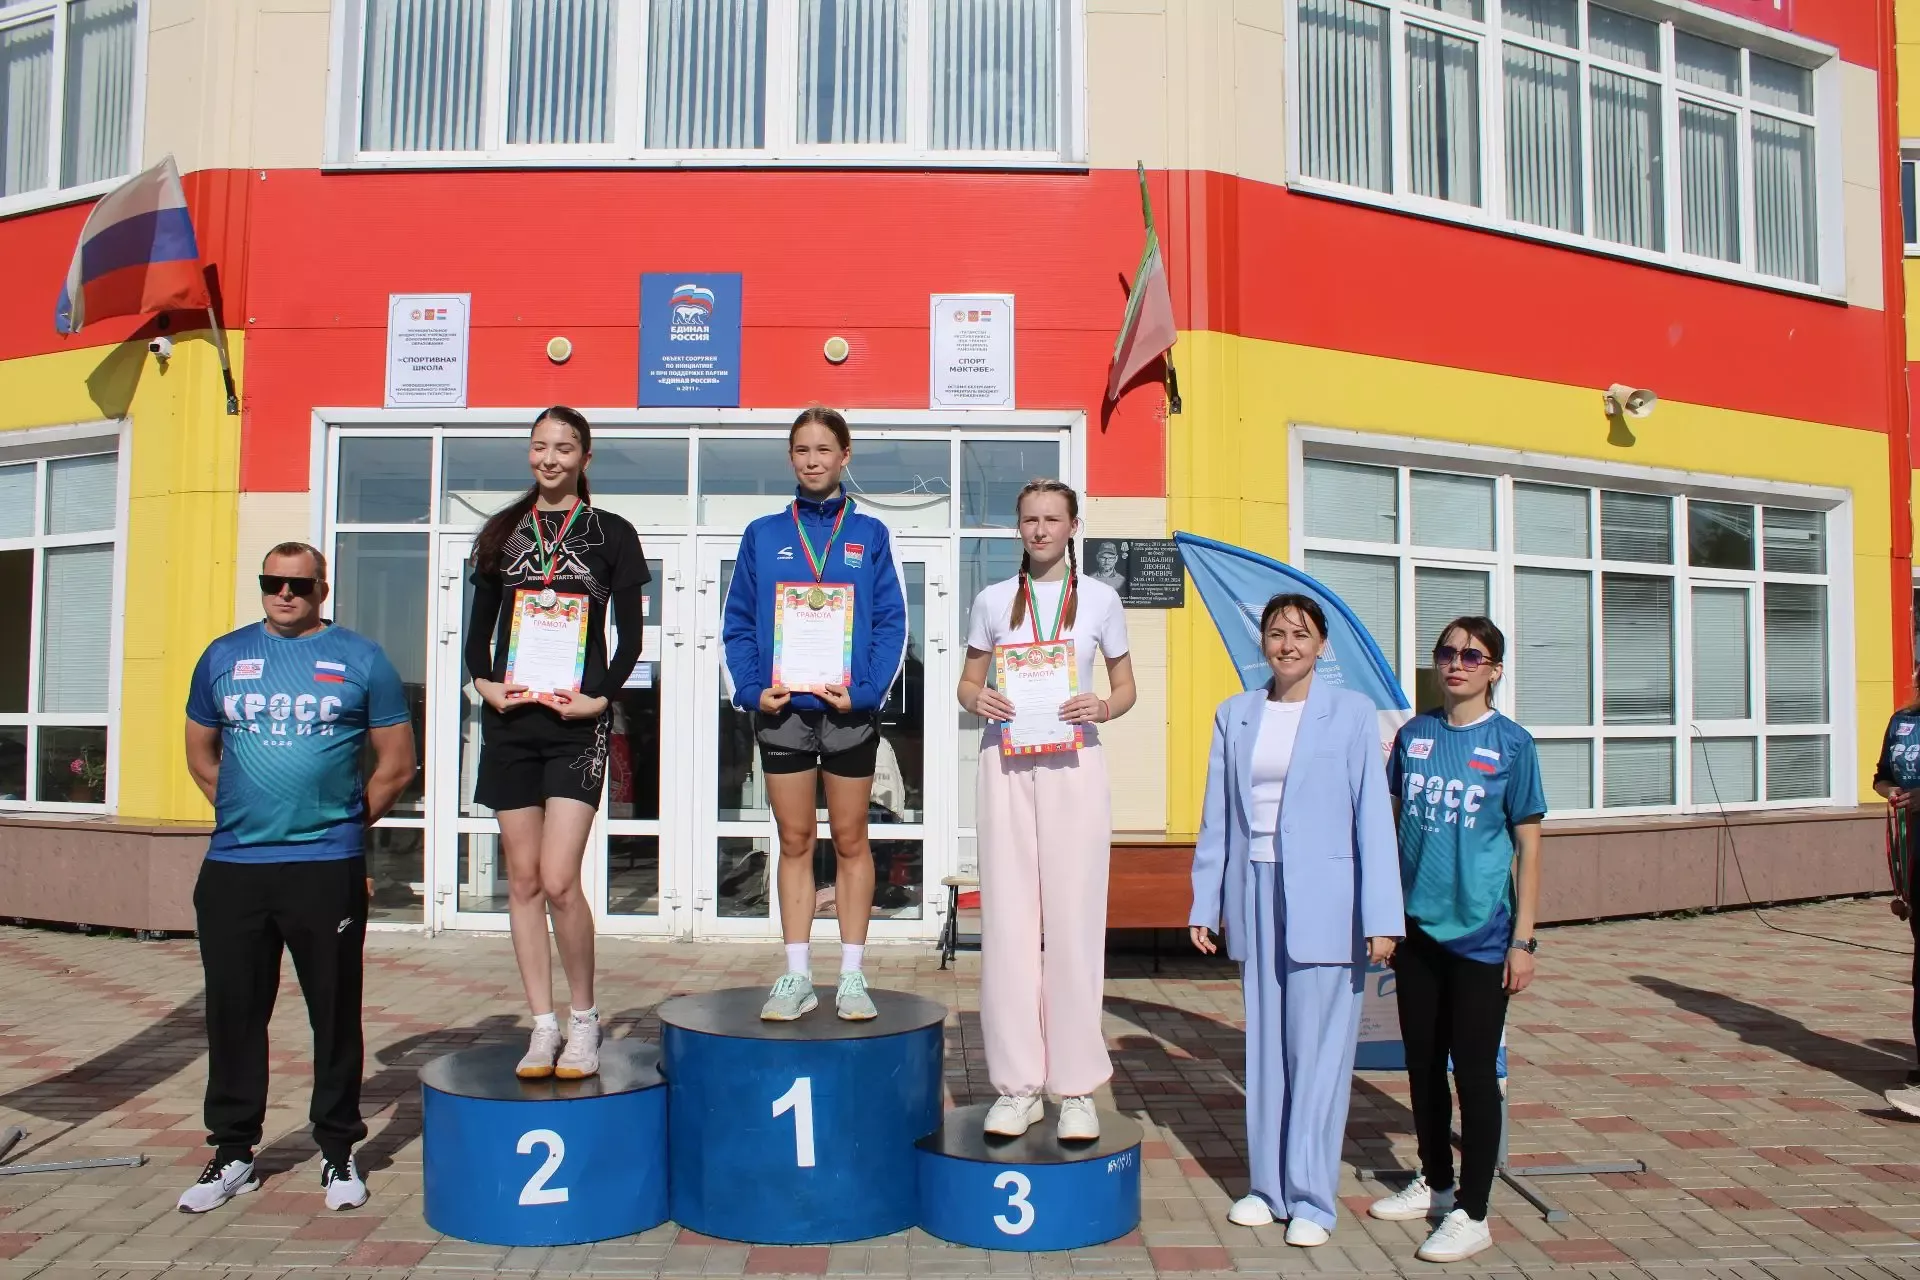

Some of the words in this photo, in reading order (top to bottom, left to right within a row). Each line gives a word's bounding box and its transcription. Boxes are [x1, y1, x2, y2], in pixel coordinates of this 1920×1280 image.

[670, 326, 710, 334] ЕДИНАЯ
[670, 333, 710, 341] РОССИЯ
[533, 619, 567, 629] ГРАМОТА
[797, 611, 832, 619] ГРАМОТА
[1018, 670, 1055, 679] ГРАМОТА
[224, 693, 342, 722] КРОСС
[1407, 803, 1476, 829] АЦИИ
[771, 1076, 817, 1168] 1
[515, 1128, 570, 1207] 2
[992, 1170, 1035, 1236] 3
